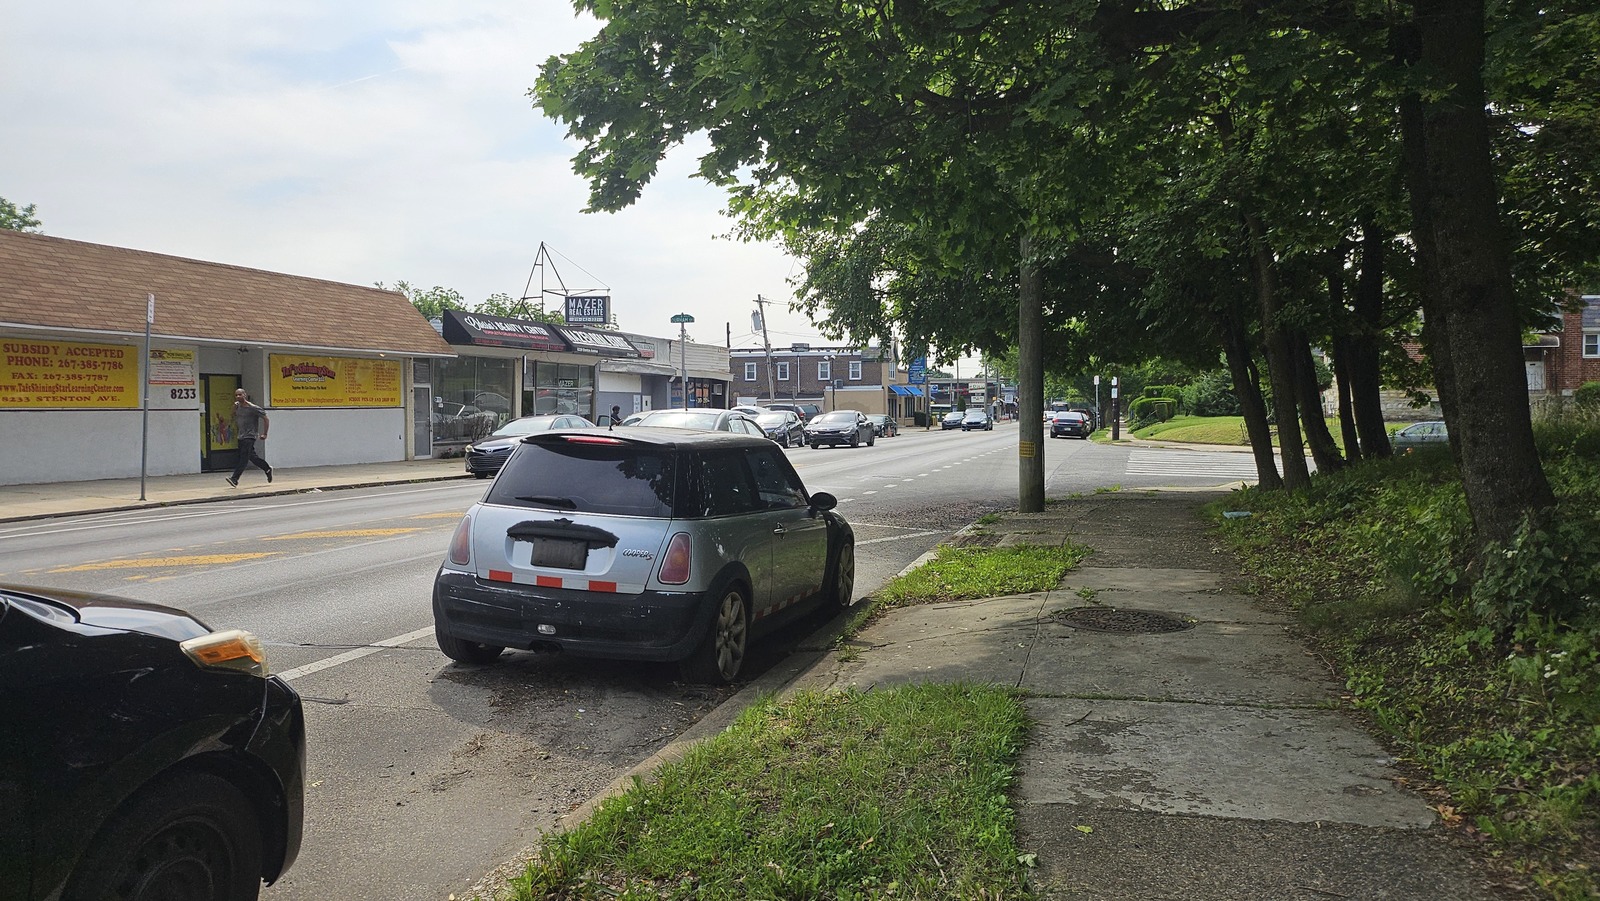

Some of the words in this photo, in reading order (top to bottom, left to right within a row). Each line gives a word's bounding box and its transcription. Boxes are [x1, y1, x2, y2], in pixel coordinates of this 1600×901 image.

[569, 299, 603, 309] MAZER
[494, 321, 525, 333] BEAUTY
[523, 325, 550, 336] CENTER
[559, 328, 600, 344] MAZER
[3, 343, 60, 356] SUBSIDY
[66, 347, 124, 359] ACCEPTED
[7, 356, 54, 367] PHONE:
[58, 359, 124, 370] 267-385-7786
[322, 365, 336, 380] Star
[170, 388, 196, 400] 8233
[622, 548, 649, 558] COOPER
